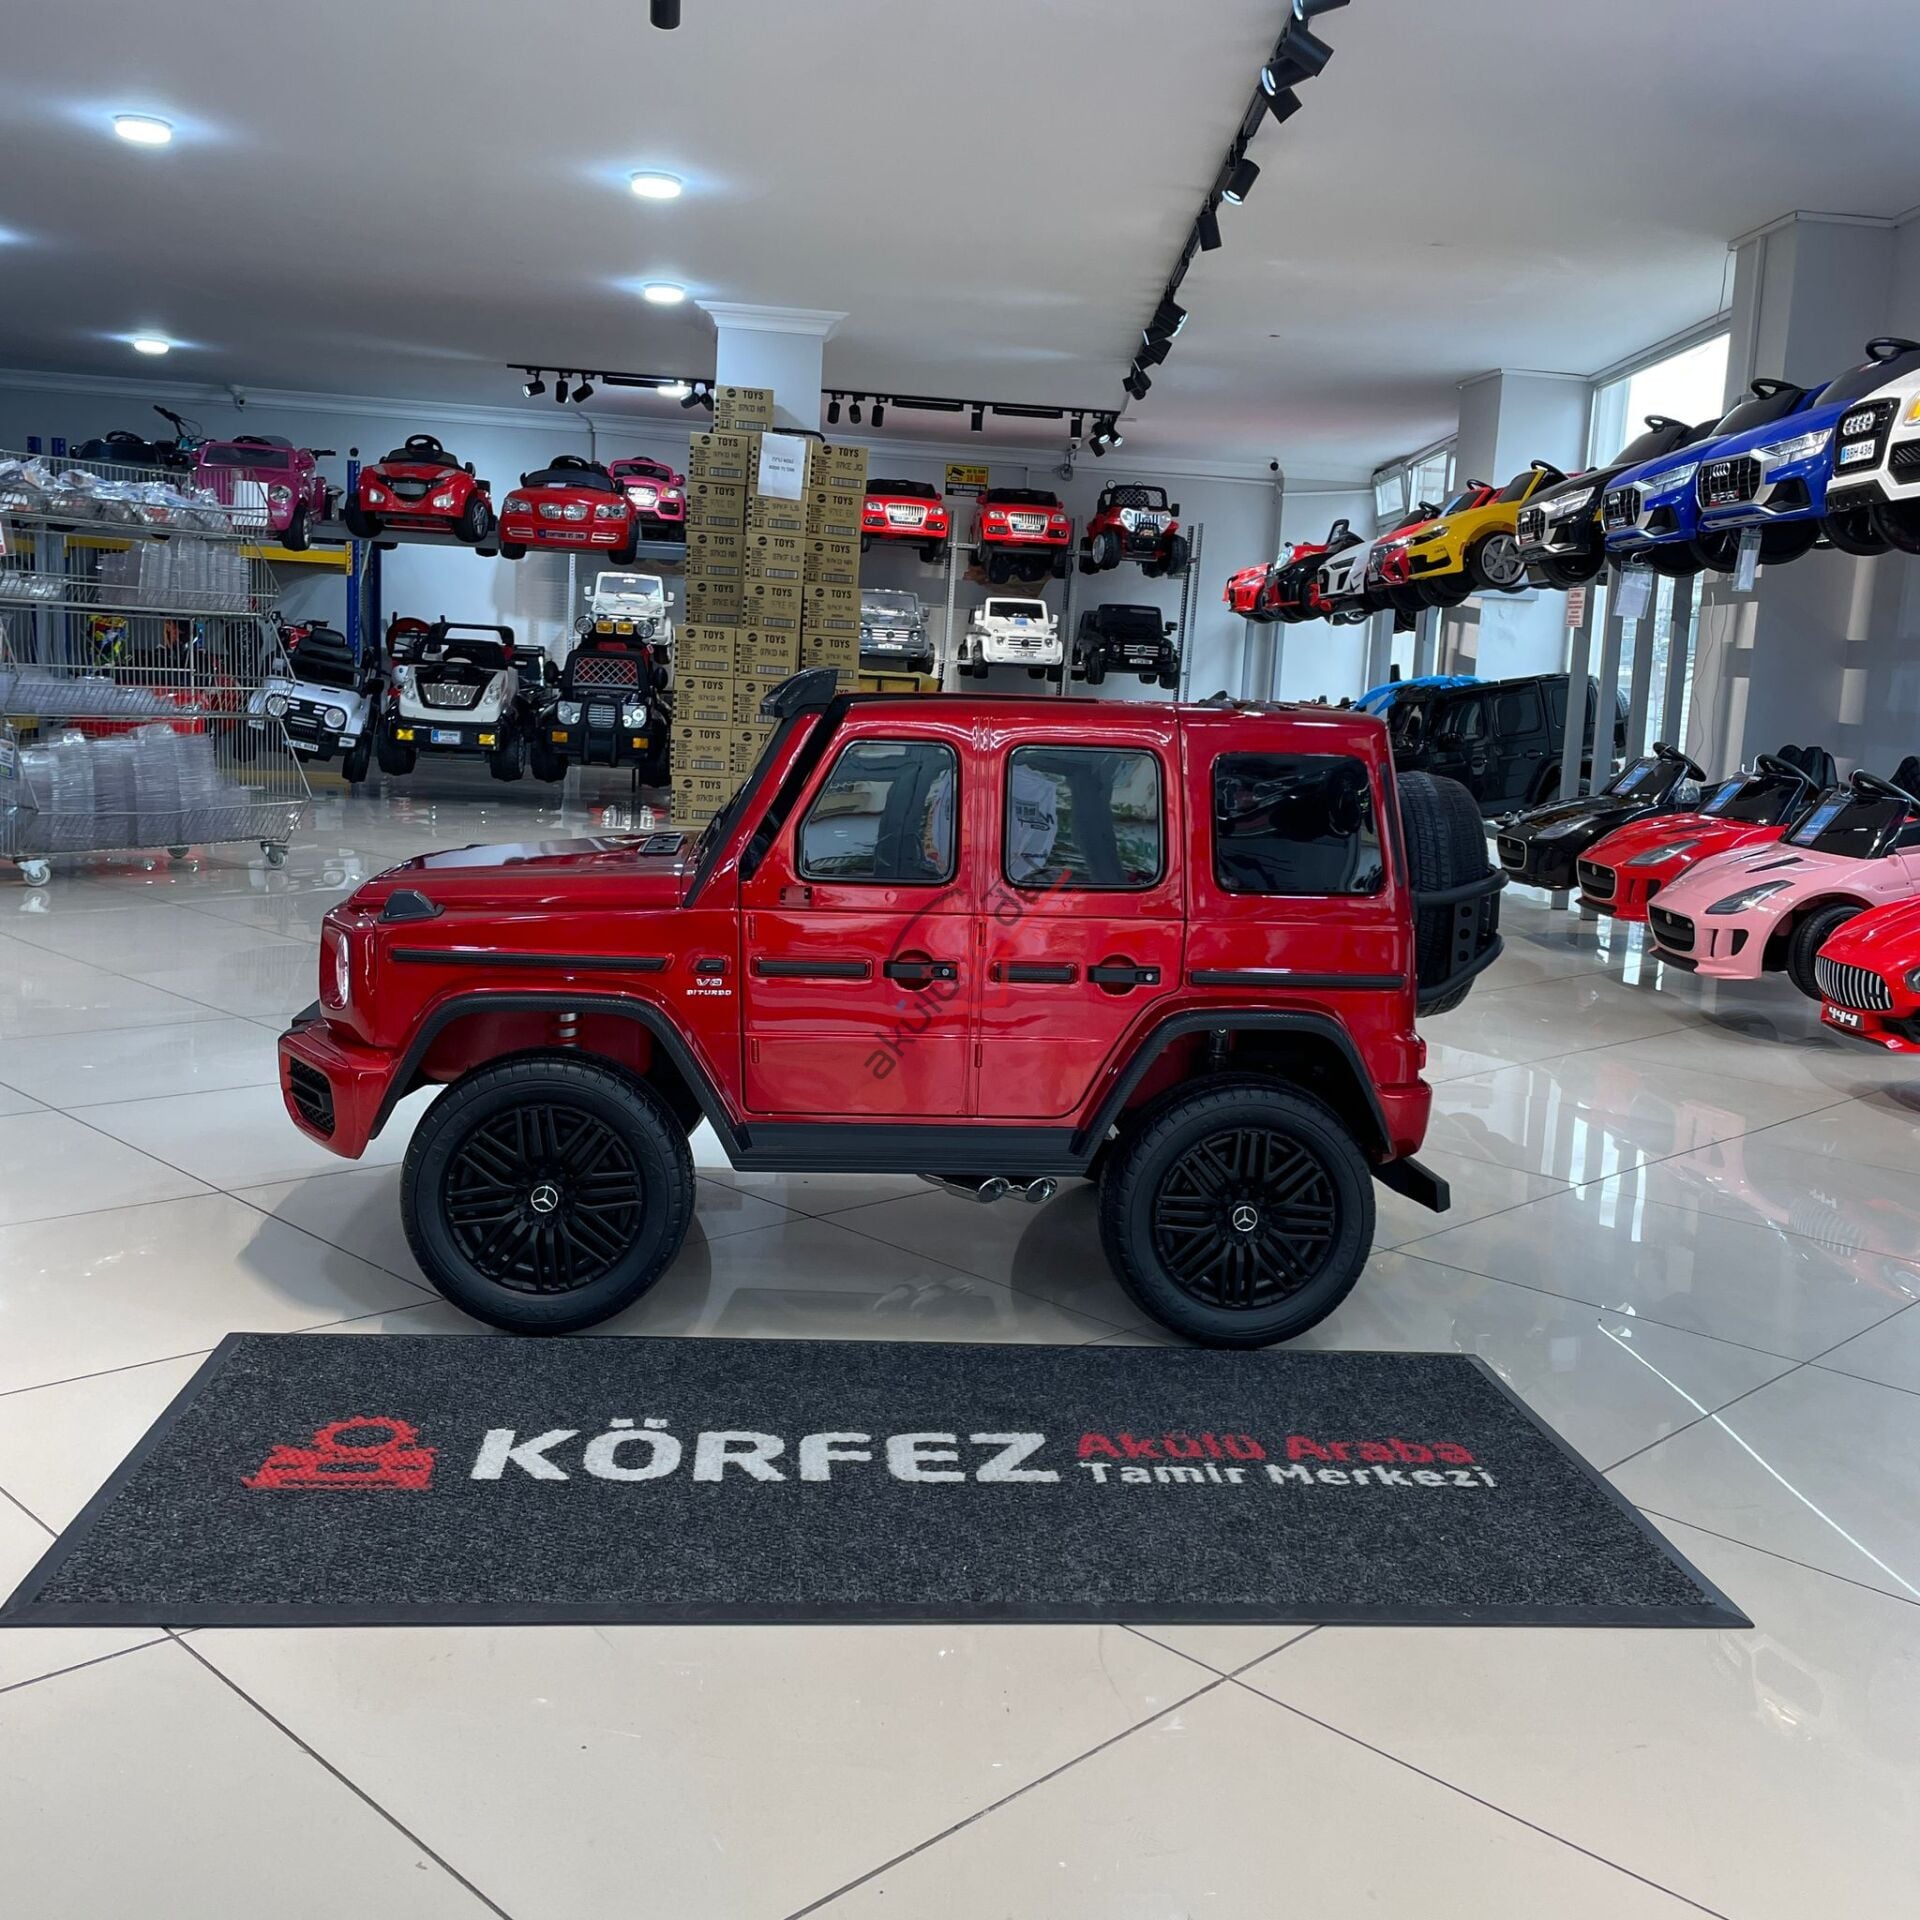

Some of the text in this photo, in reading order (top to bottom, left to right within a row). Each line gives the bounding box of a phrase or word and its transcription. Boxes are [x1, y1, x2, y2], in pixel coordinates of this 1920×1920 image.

[742, 390, 764, 400] TOYS
[717, 437, 738, 448] TOYS
[838, 447, 859, 458] TOYS
[714, 486, 735, 497] TOYS
[832, 495, 854, 506] TOYS
[714, 535, 735, 546] TOYS
[774, 538, 795, 549] TOYS
[830, 543, 851, 554] TOYS
[713, 584, 734, 594] TOYS
[771, 586, 793, 597] TOYS
[831, 589, 852, 599] TOYS
[703, 630, 725, 640] TOYS
[765, 634, 786, 645] TOYS
[829, 638, 850, 649] TOYS
[702, 680, 724, 690] TOYS
[699, 729, 721, 740] TOYS
[699, 780, 721, 790] TOYS
[1828, 1006, 1859, 1027] 444
[470, 1417, 1060, 1483] KÖRFEZ
[1285, 1434, 1475, 1465] Araba
[1077, 1461, 1246, 1484] Tamir
[1263, 1463, 1498, 1488] Merkezi
